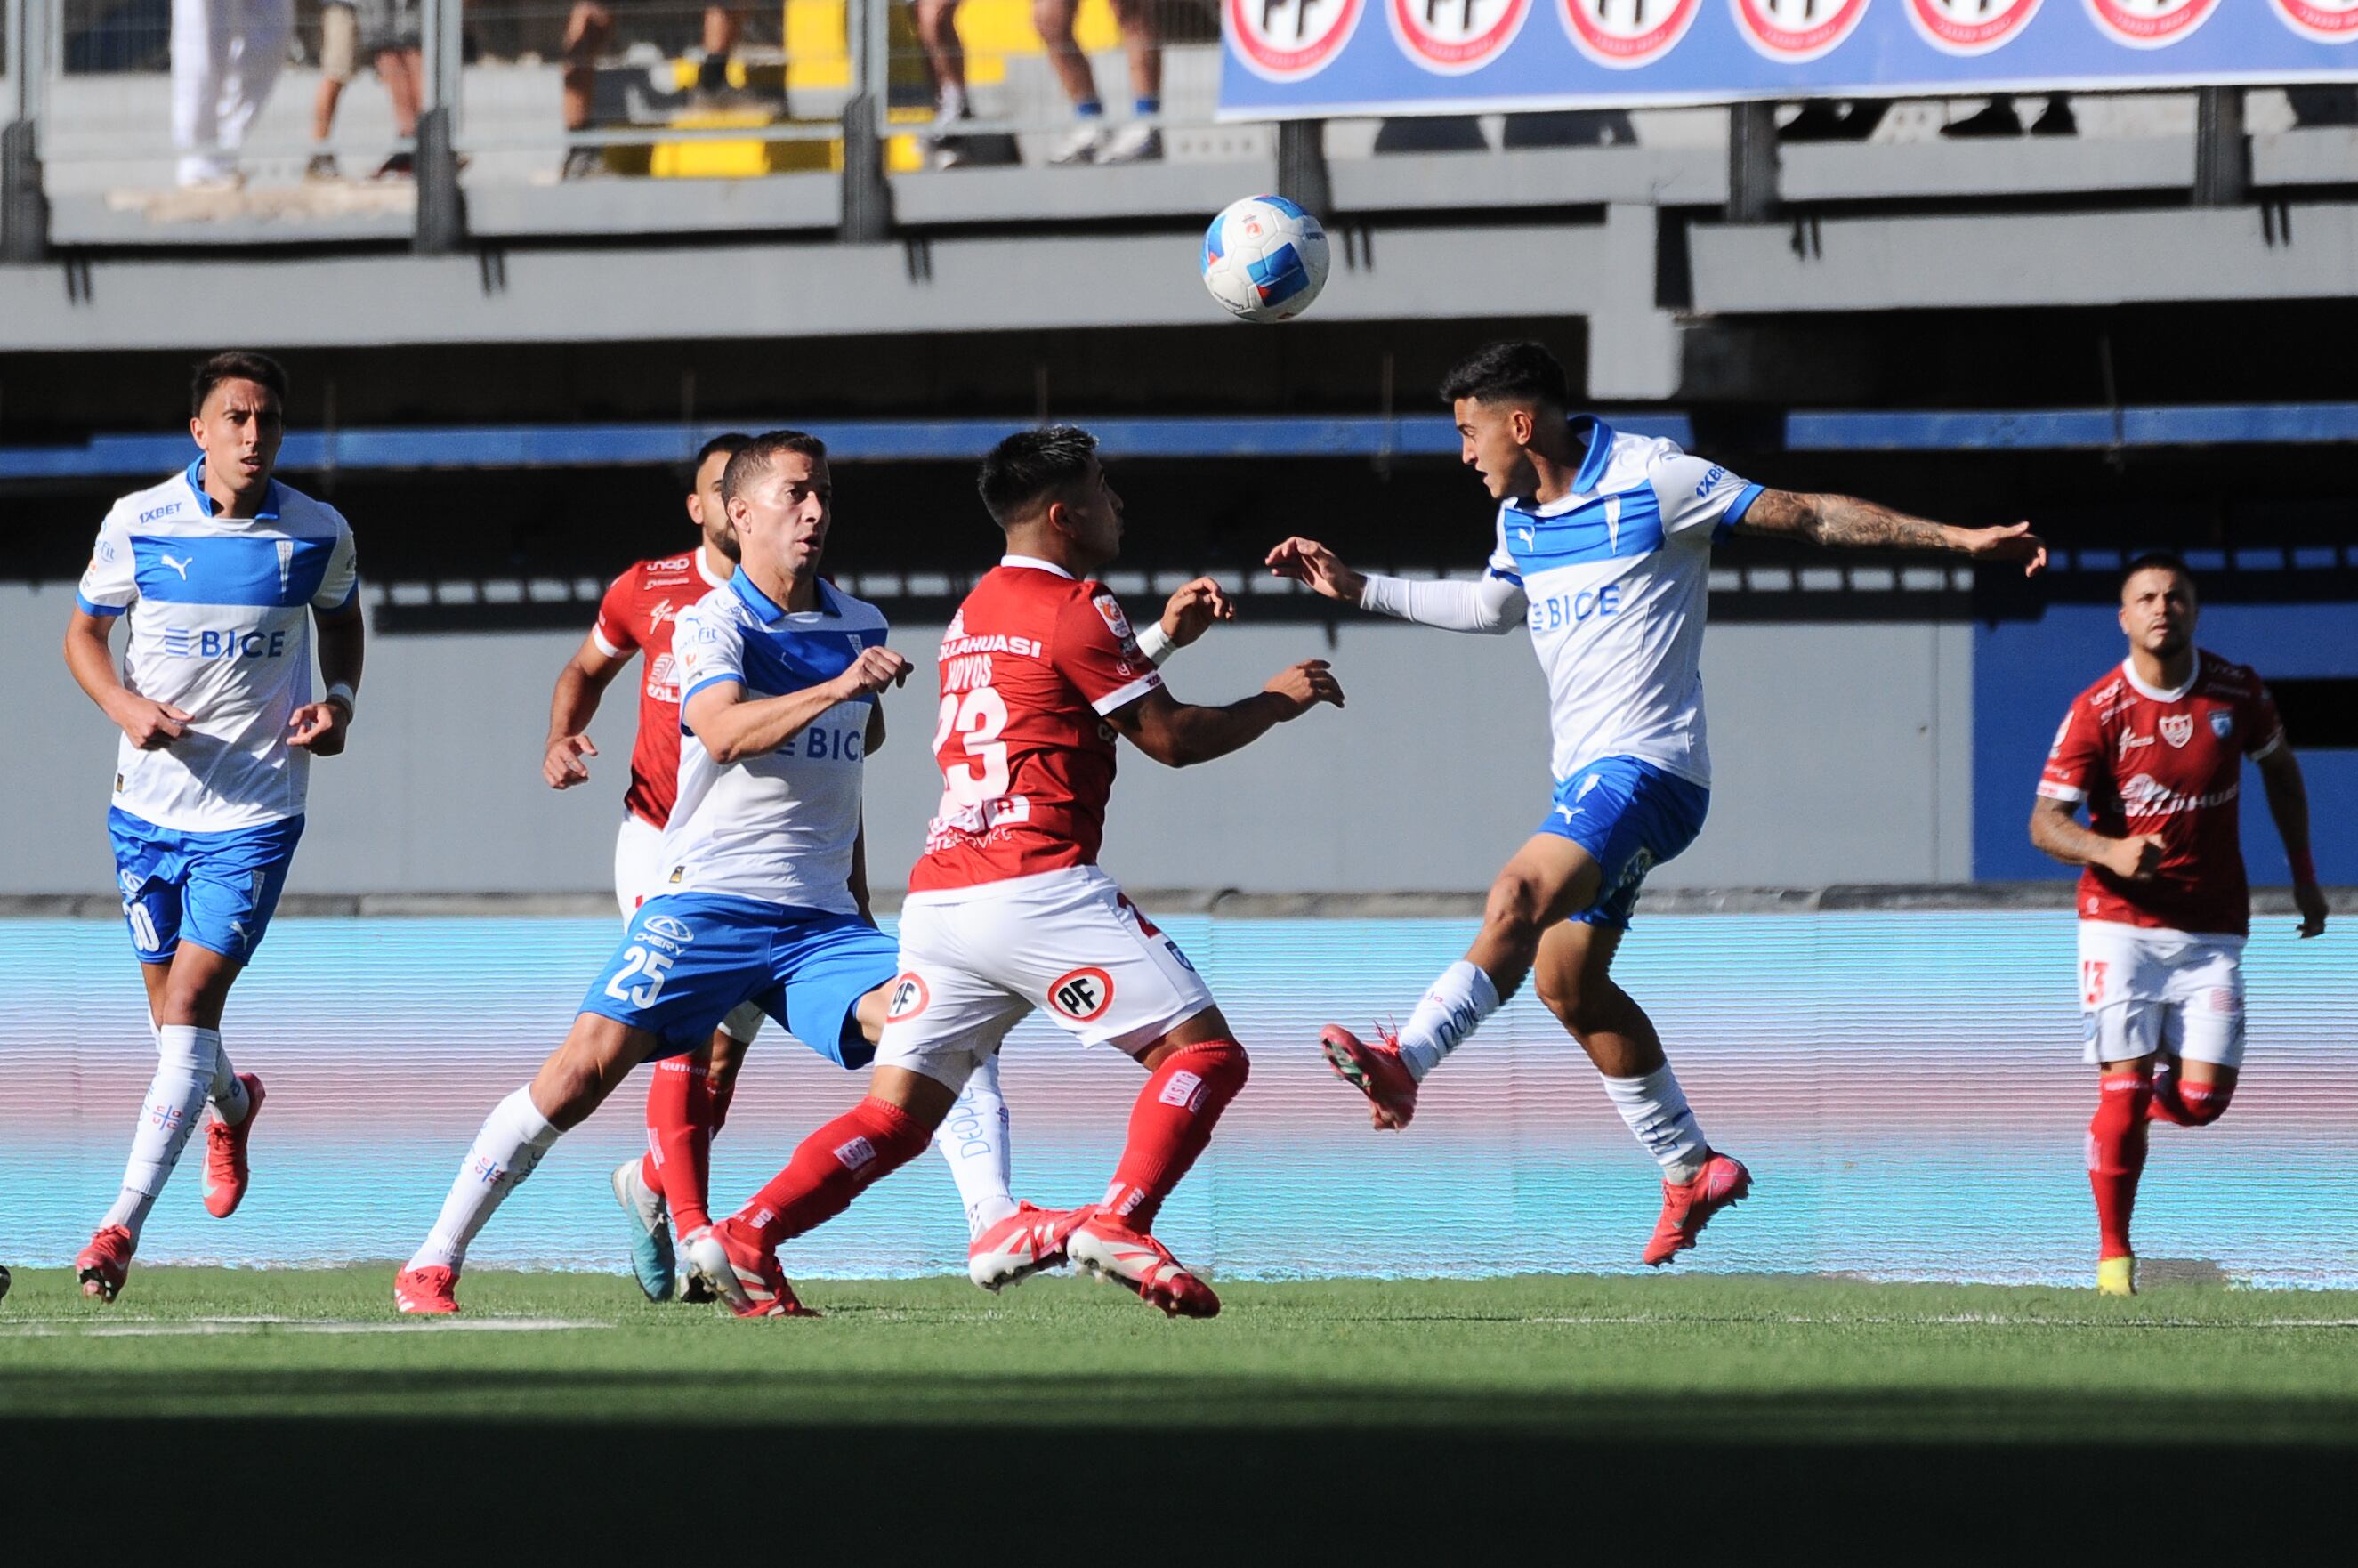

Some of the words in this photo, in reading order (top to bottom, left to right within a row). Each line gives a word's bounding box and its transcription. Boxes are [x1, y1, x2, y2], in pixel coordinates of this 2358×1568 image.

[140, 502, 182, 525] 1XBET
[1549, 585, 1621, 629] BICE
[201, 630, 286, 659] BICE
[806, 726, 864, 763] BIC
[634, 932, 686, 956] CHERY
[605, 946, 674, 1009] 25
[1058, 978, 1096, 1015] PF
